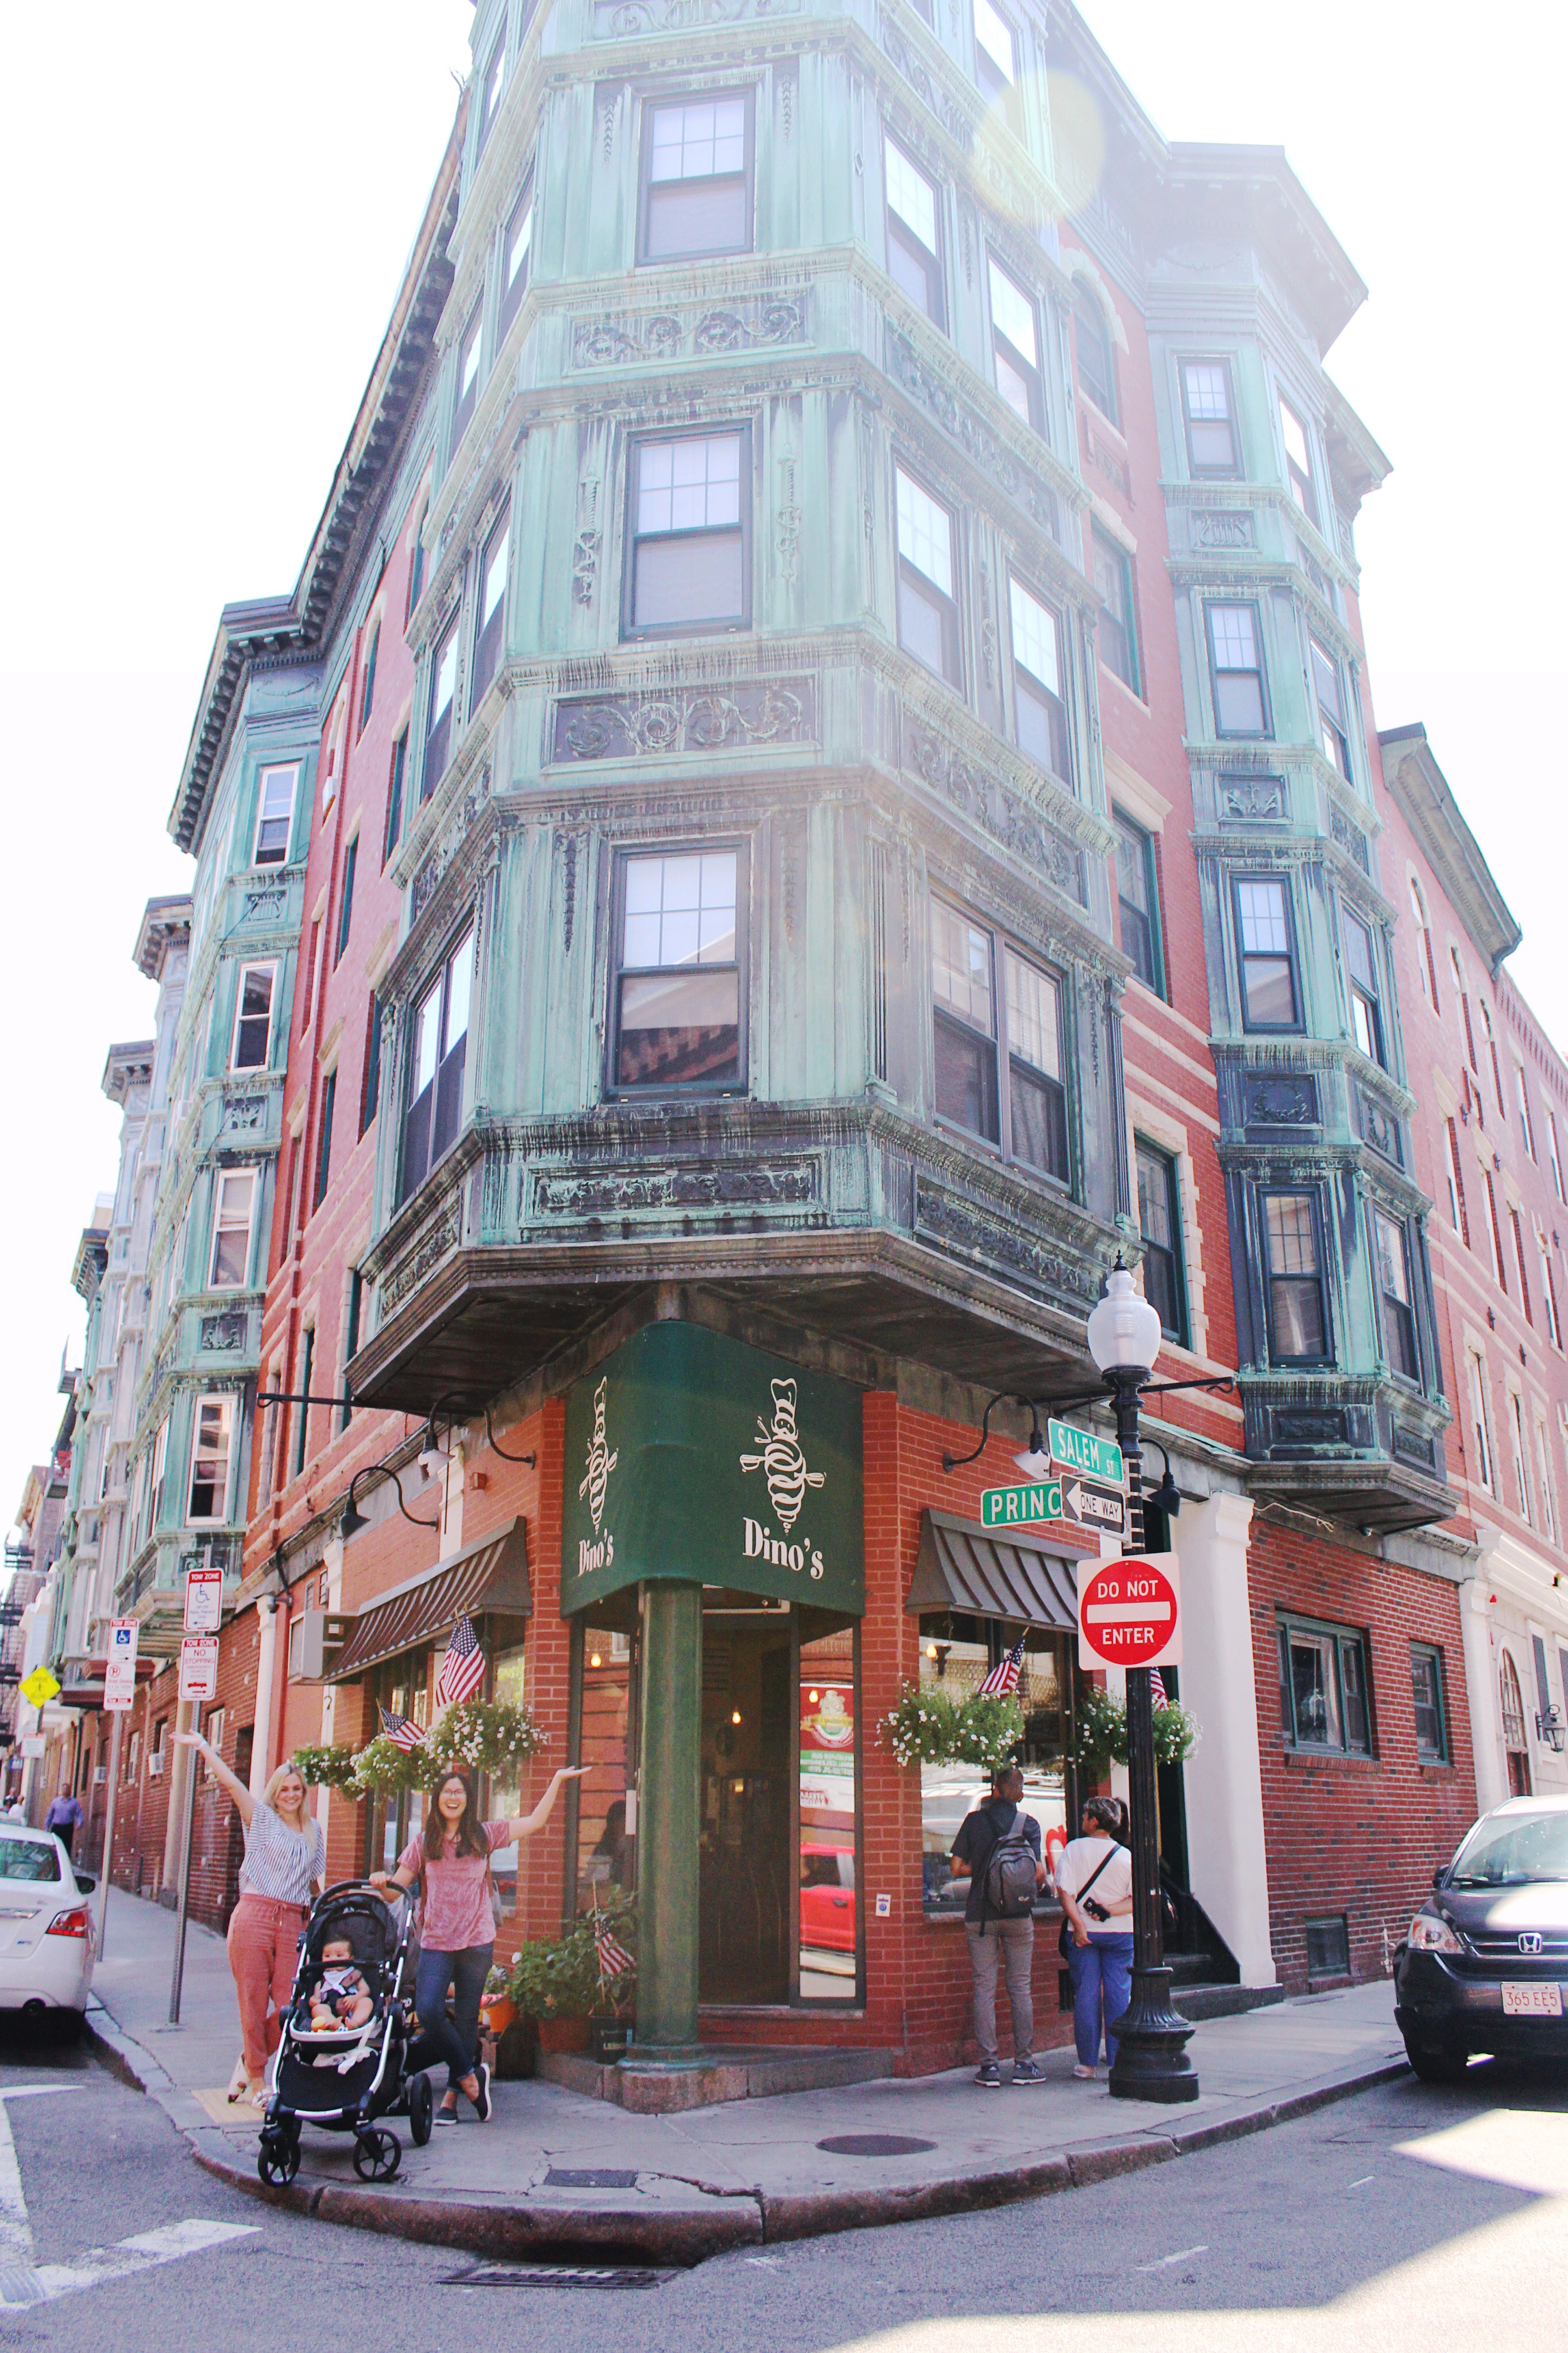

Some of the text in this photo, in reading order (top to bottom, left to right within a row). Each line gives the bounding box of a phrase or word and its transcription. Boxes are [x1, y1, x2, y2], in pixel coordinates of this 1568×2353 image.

[1058, 1427, 1115, 1475] SALEM ST
[991, 1487, 1061, 1522] PRINC
[1080, 1494, 1119, 1519] ONE WAY
[578, 1528, 613, 1577] Dino's
[742, 1517, 824, 1580] Dino's
[1098, 1580, 1158, 1598] DO NOT
[1102, 1627, 1154, 1645] ENTER
[1505, 1992, 1557, 2007] 365 EE5
